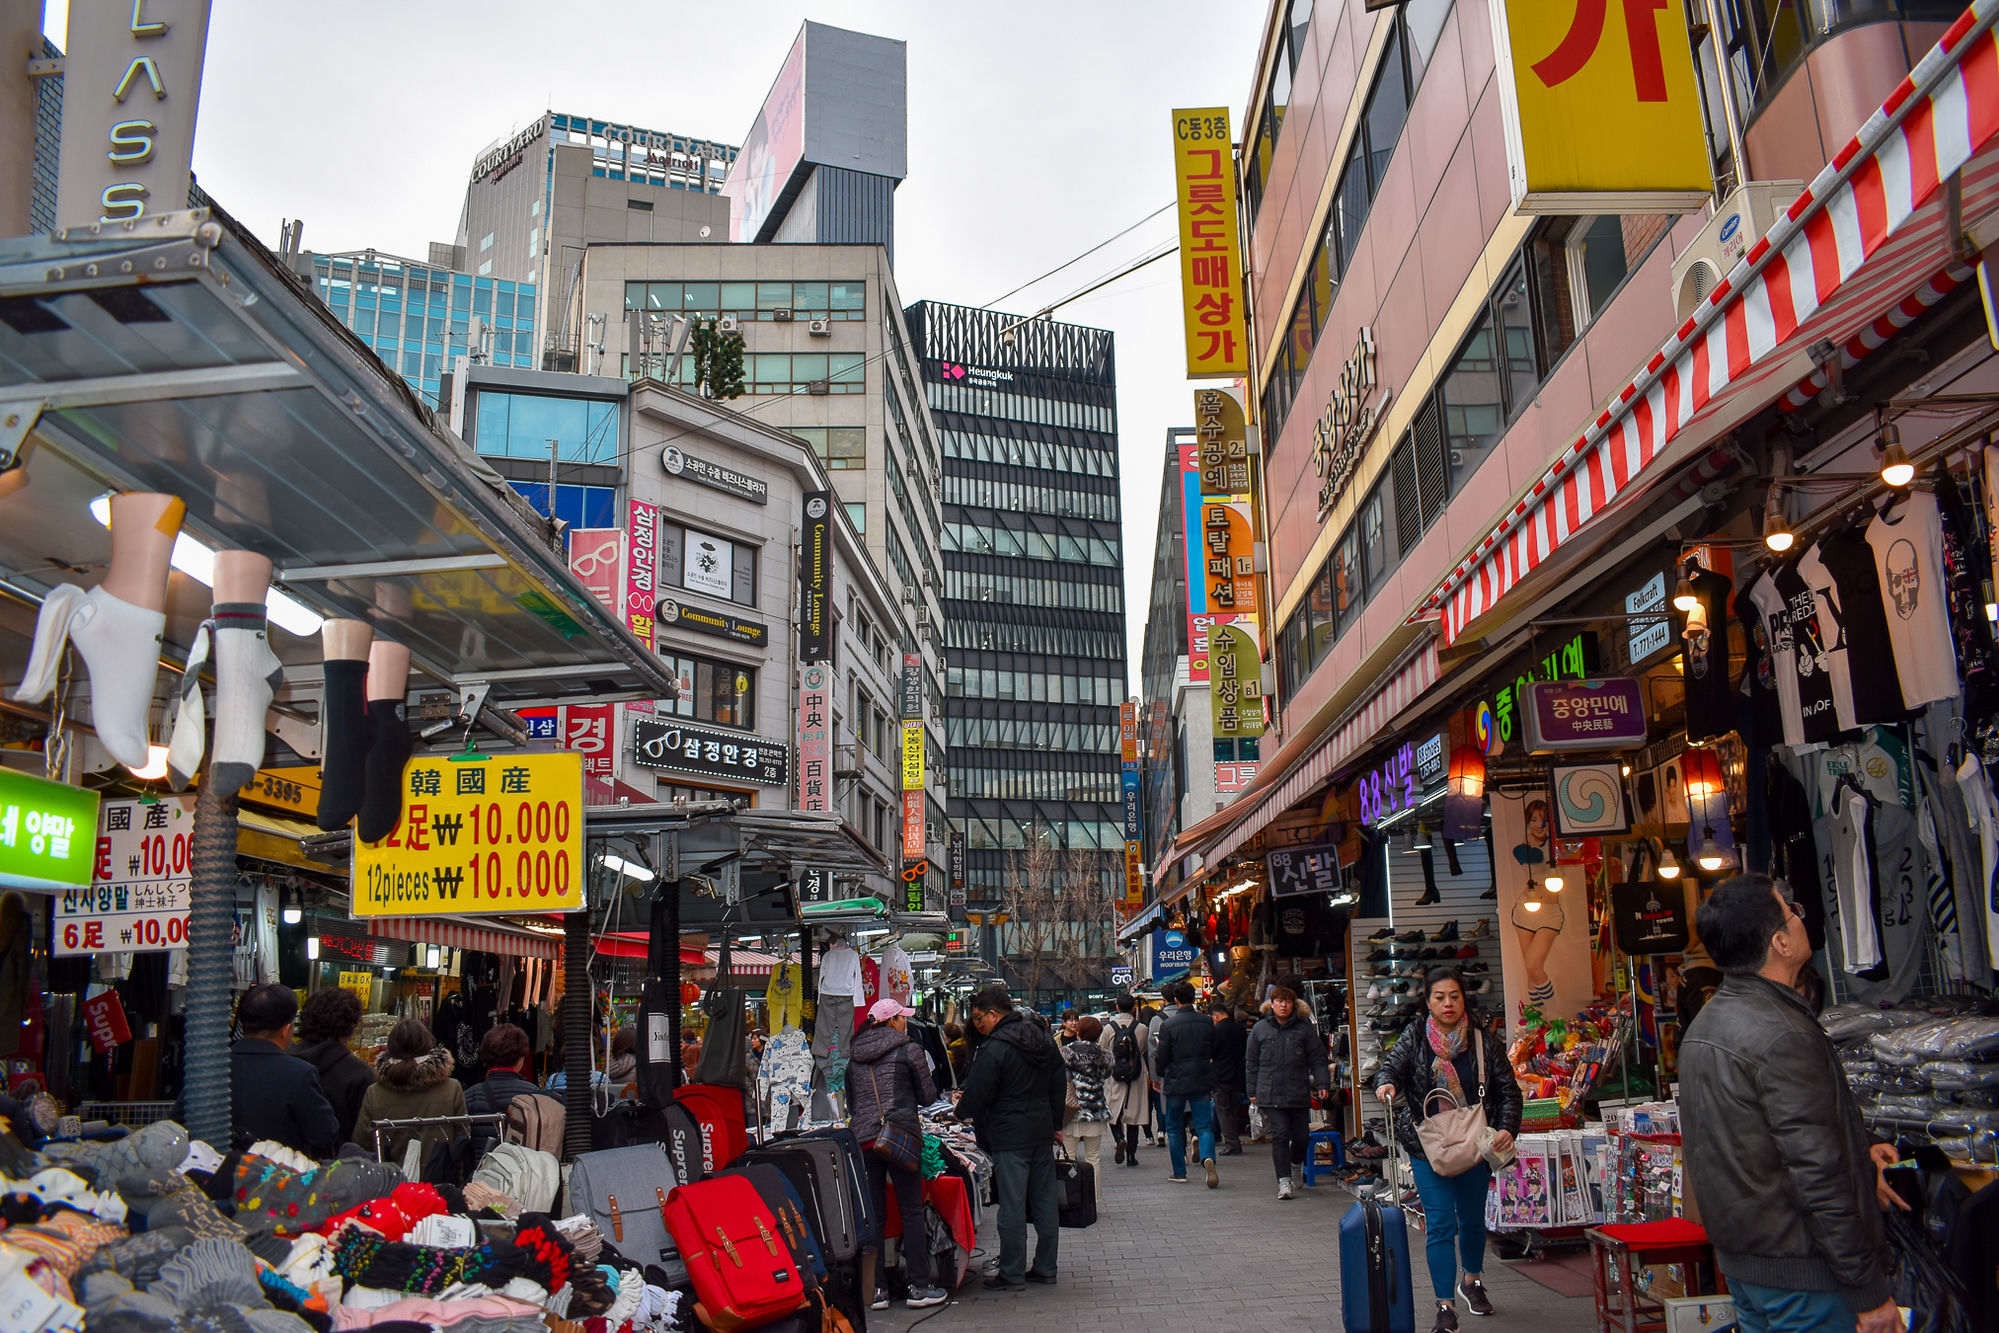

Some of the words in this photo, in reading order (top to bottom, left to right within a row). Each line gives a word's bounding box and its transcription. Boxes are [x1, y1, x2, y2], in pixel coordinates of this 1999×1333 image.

[472, 119, 545, 184] COURTYARD
[1186, 149, 1237, 364] 그릇도매상가
[968, 366, 1014, 381] Heungkuk
[1230, 441, 1244, 456] 2F
[686, 458, 706, 474] 소공인
[631, 505, 656, 591] 삼정안경
[811, 523, 825, 590] Community
[1206, 508, 1234, 607] 토탈패션
[1238, 558, 1251, 573] 1F
[631, 614, 653, 649] 할
[681, 607, 729, 632] Community
[732, 620, 761, 639] Lounge
[810, 593, 824, 637] Lounge
[1214, 629, 1240, 732] 수입상품
[1496, 633, 1585, 742] 중예
[806, 694, 823, 728] 中央
[1553, 695, 1629, 719] 중앙민예
[683, 737, 758, 768] 삼정안경
[806, 760, 823, 811] 百貨店
[1220, 766, 1258, 786] 그릇
[25, 811, 75, 859] 양말
[1273, 853, 1292, 867] 88
[1282, 852, 1336, 891] 신발
[63, 885, 129, 913] 신사양말
[134, 883, 193, 895] しんしくつ
[367, 864, 429, 907] 12pieces
[1159, 951, 1192, 961] 우리은행
[360, 973, 371, 984] OK
